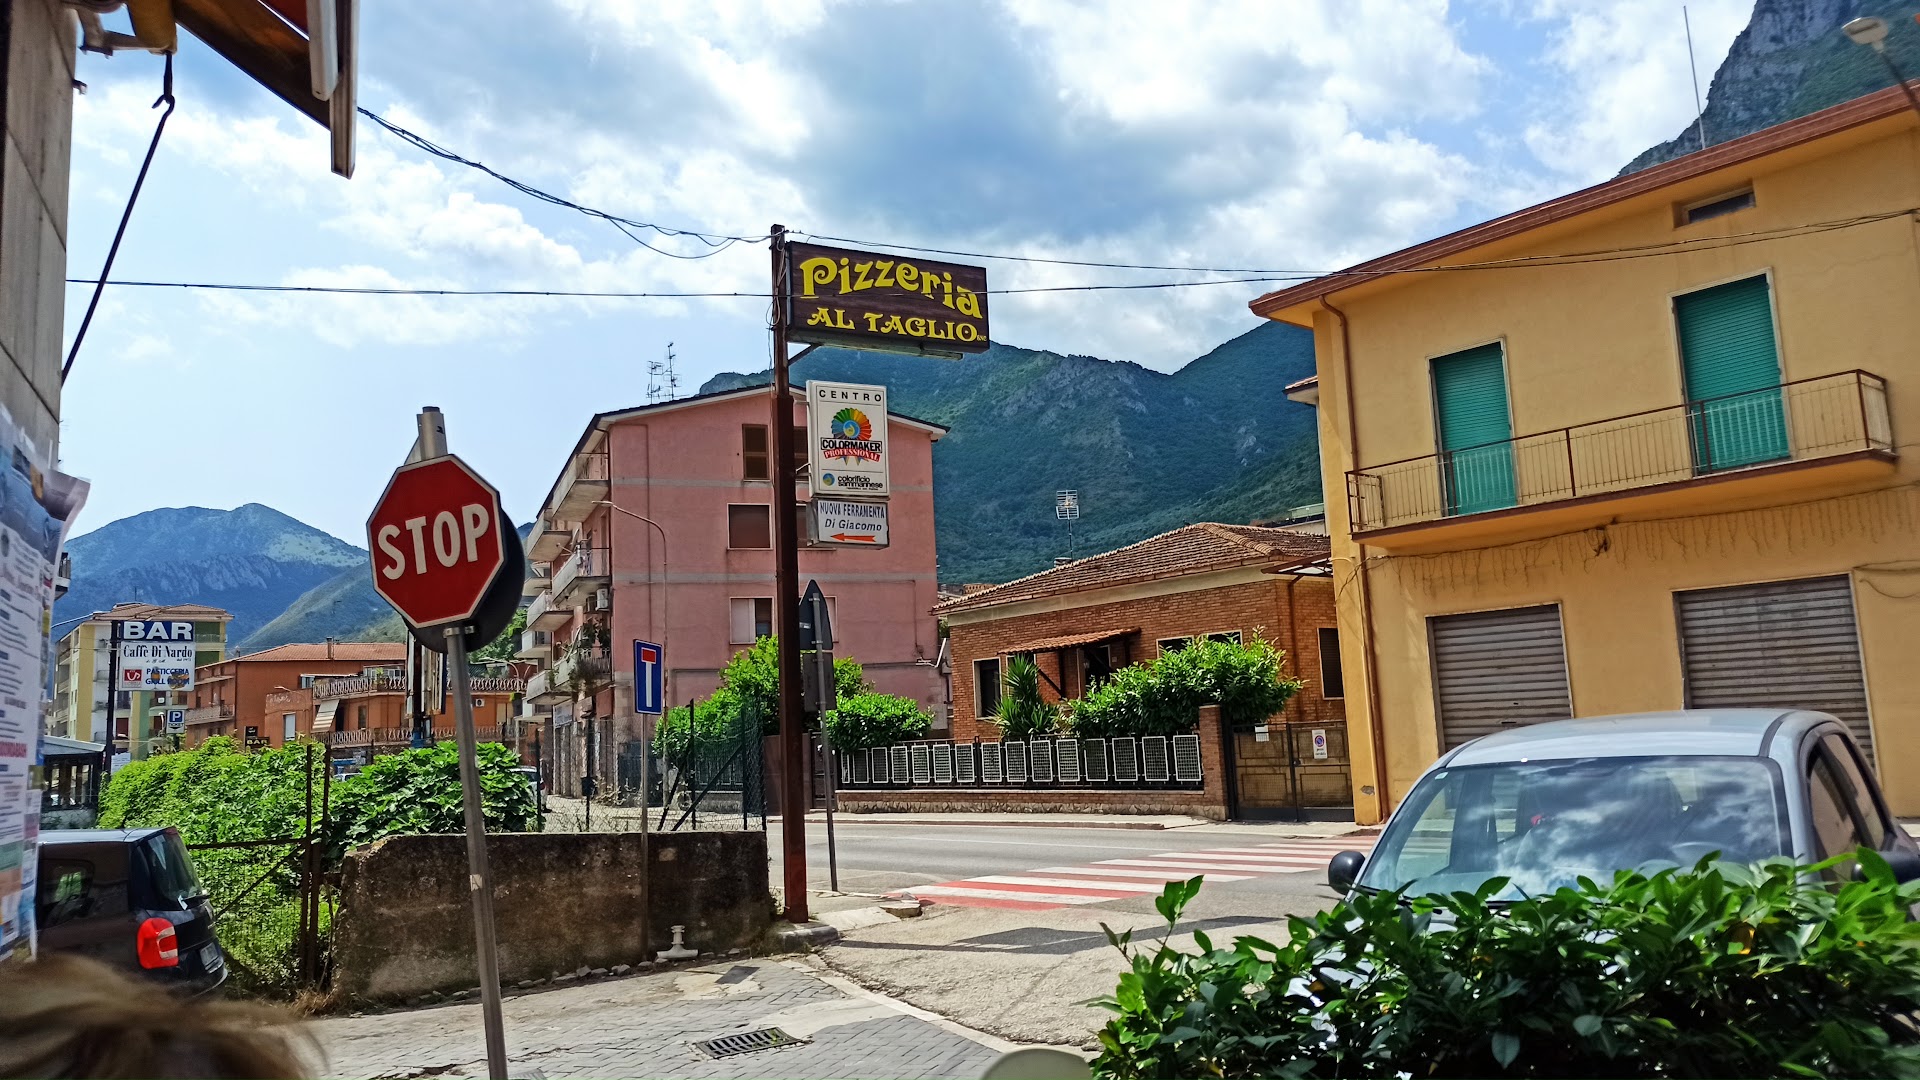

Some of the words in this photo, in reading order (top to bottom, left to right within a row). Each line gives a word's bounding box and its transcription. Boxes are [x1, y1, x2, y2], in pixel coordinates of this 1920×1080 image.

[800, 257, 983, 319] Pizzeria
[807, 307, 855, 330] AL
[863, 312, 978, 342] TAGLIO
[819, 389, 882, 402] CENTRO
[822, 440, 881, 452] COLORMAKER
[824, 448, 880, 462] PROFESSIONAL
[838, 475, 870, 484] colorificio
[820, 502, 841, 515] NUOVA
[843, 504, 885, 518] FERRAMENTA
[825, 518, 836, 528] Di
[838, 519, 882, 531] Giacomo
[377, 503, 490, 580] STOP
[123, 621, 193, 640] BAR
[151, 645, 162, 657] Di
[165, 645, 193, 657] Nardo
[172, 711, 182, 722] P
